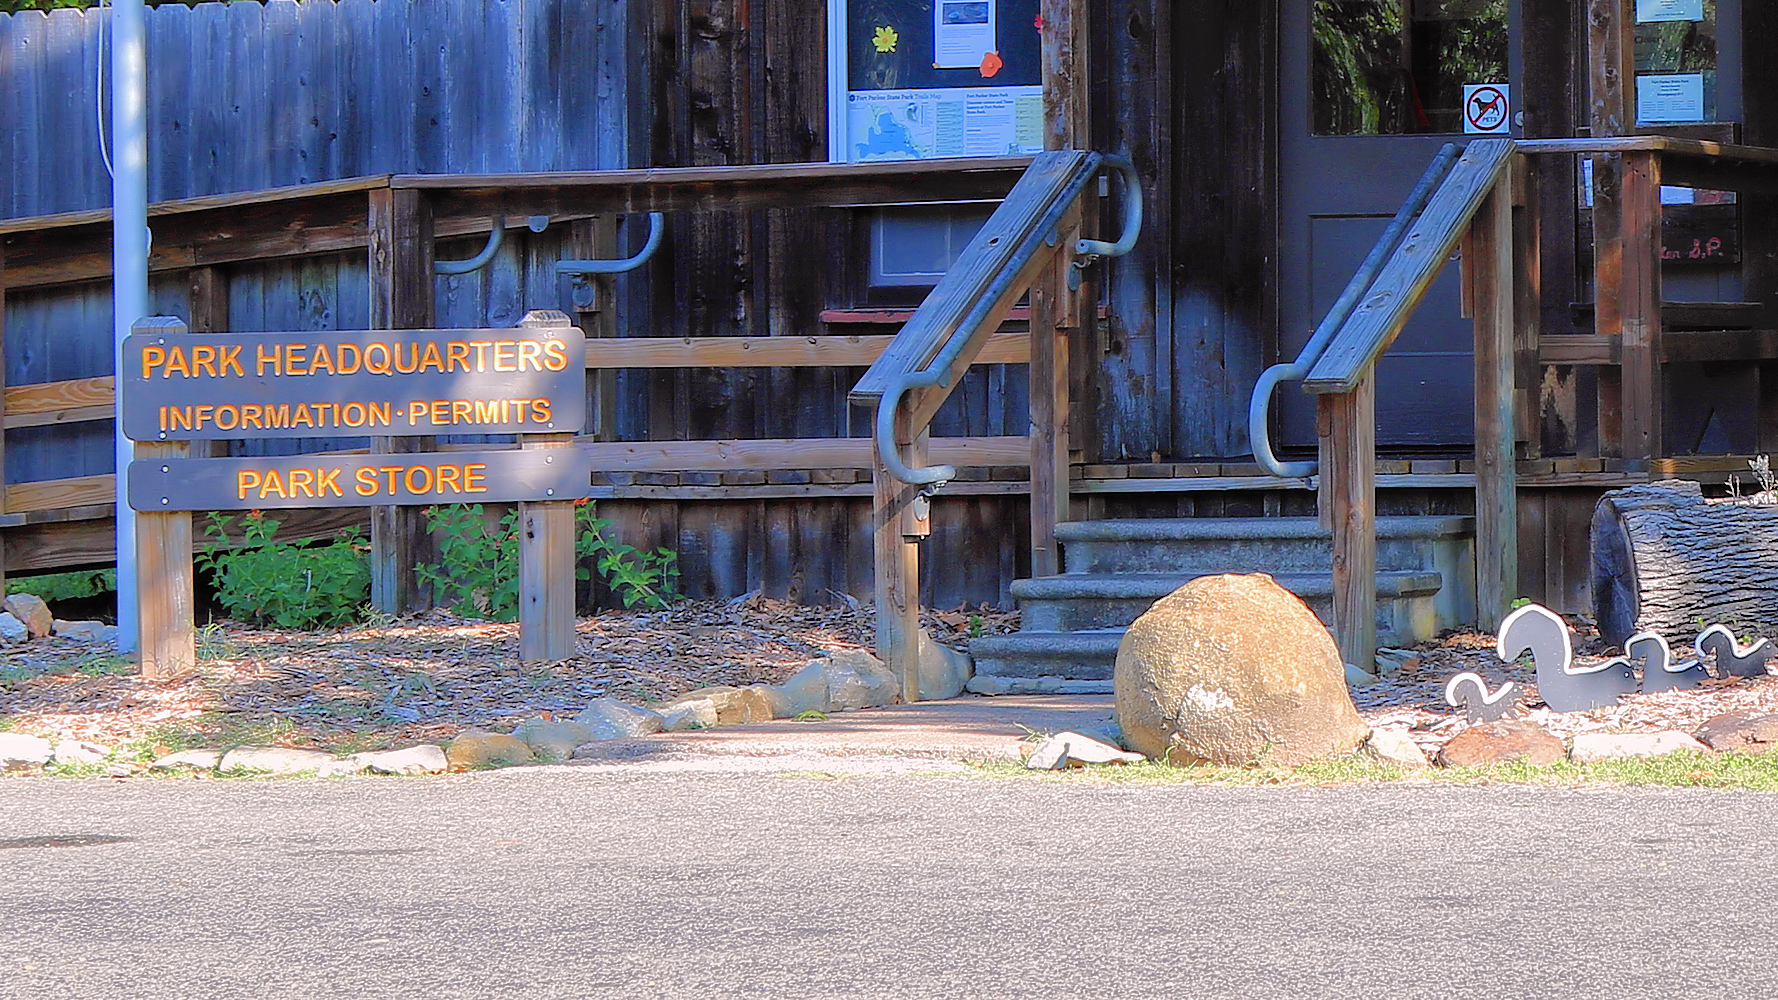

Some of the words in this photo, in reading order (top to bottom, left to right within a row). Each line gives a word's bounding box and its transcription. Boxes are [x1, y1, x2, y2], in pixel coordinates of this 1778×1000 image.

[141, 343, 245, 380] PARK
[256, 338, 570, 377] HEADQUARTERS
[237, 467, 343, 500] PARK
[354, 463, 488, 496] STORE
